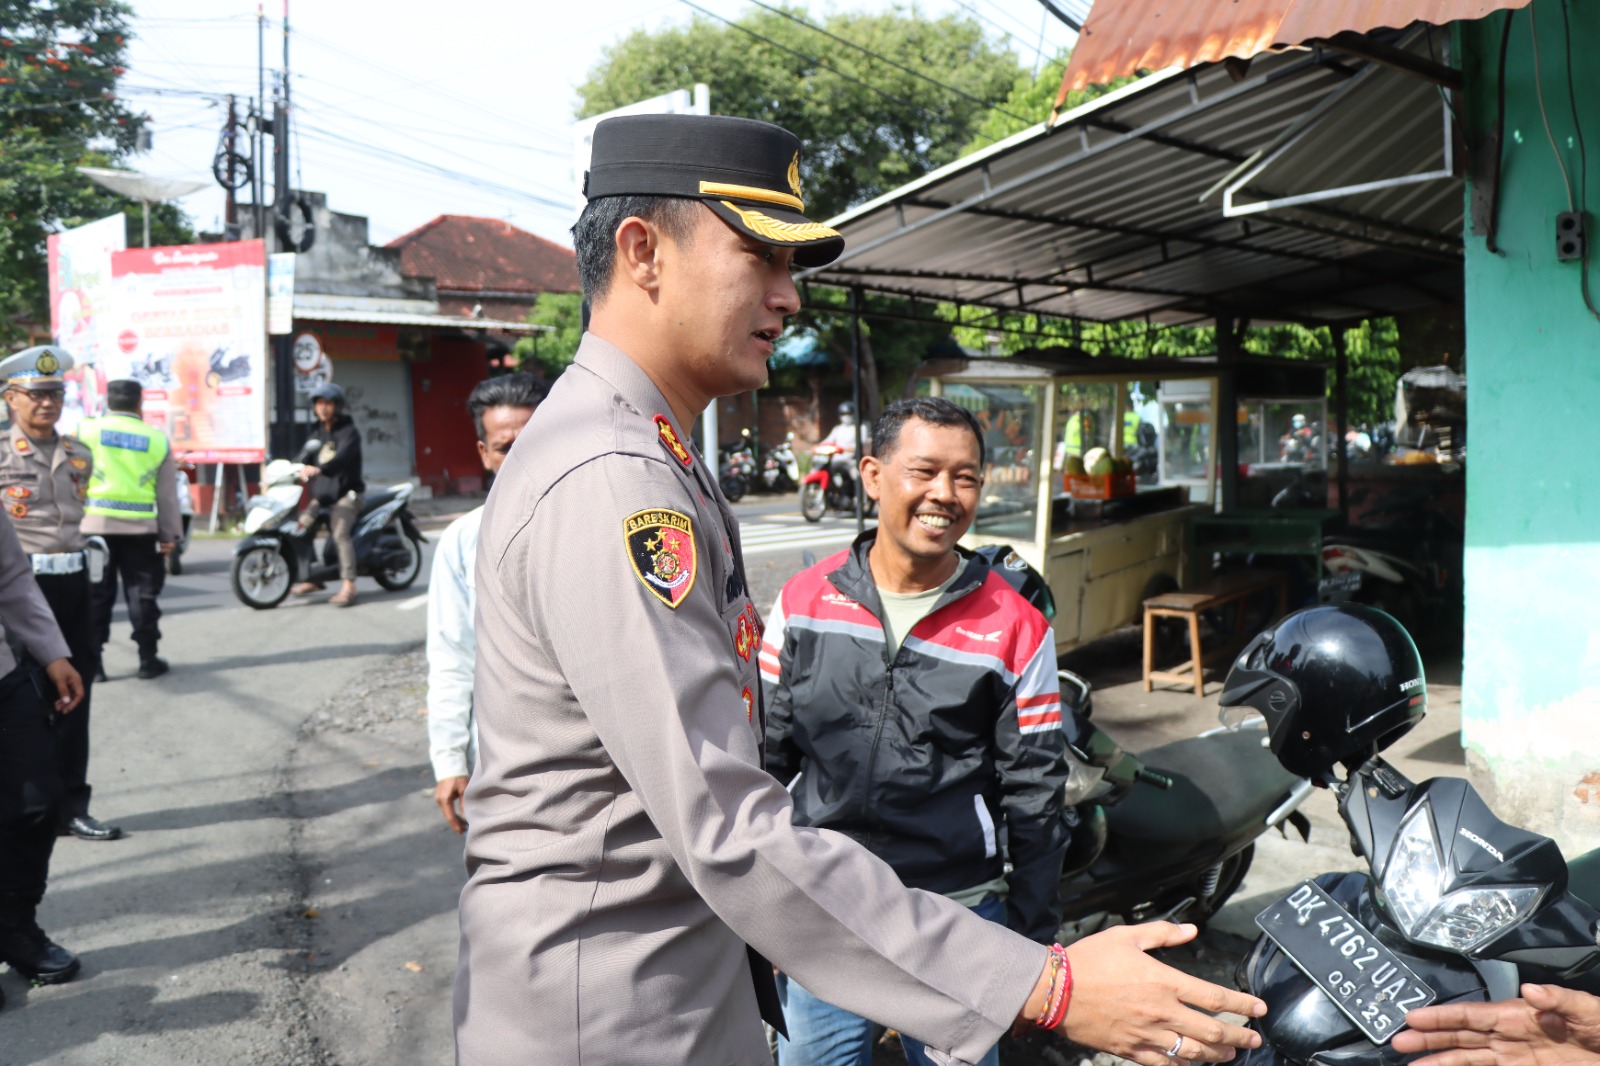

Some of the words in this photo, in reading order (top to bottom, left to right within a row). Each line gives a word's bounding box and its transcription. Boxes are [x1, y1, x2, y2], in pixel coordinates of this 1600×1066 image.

[294, 342, 314, 360] 25
[102, 431, 148, 450] POLISI
[628, 513, 688, 530] BARESKRIM
[1459, 827, 1504, 863] HONDA
[1287, 885, 1326, 920] DK
[1319, 915, 1378, 970] 4762
[1371, 962, 1427, 1014] UAZ
